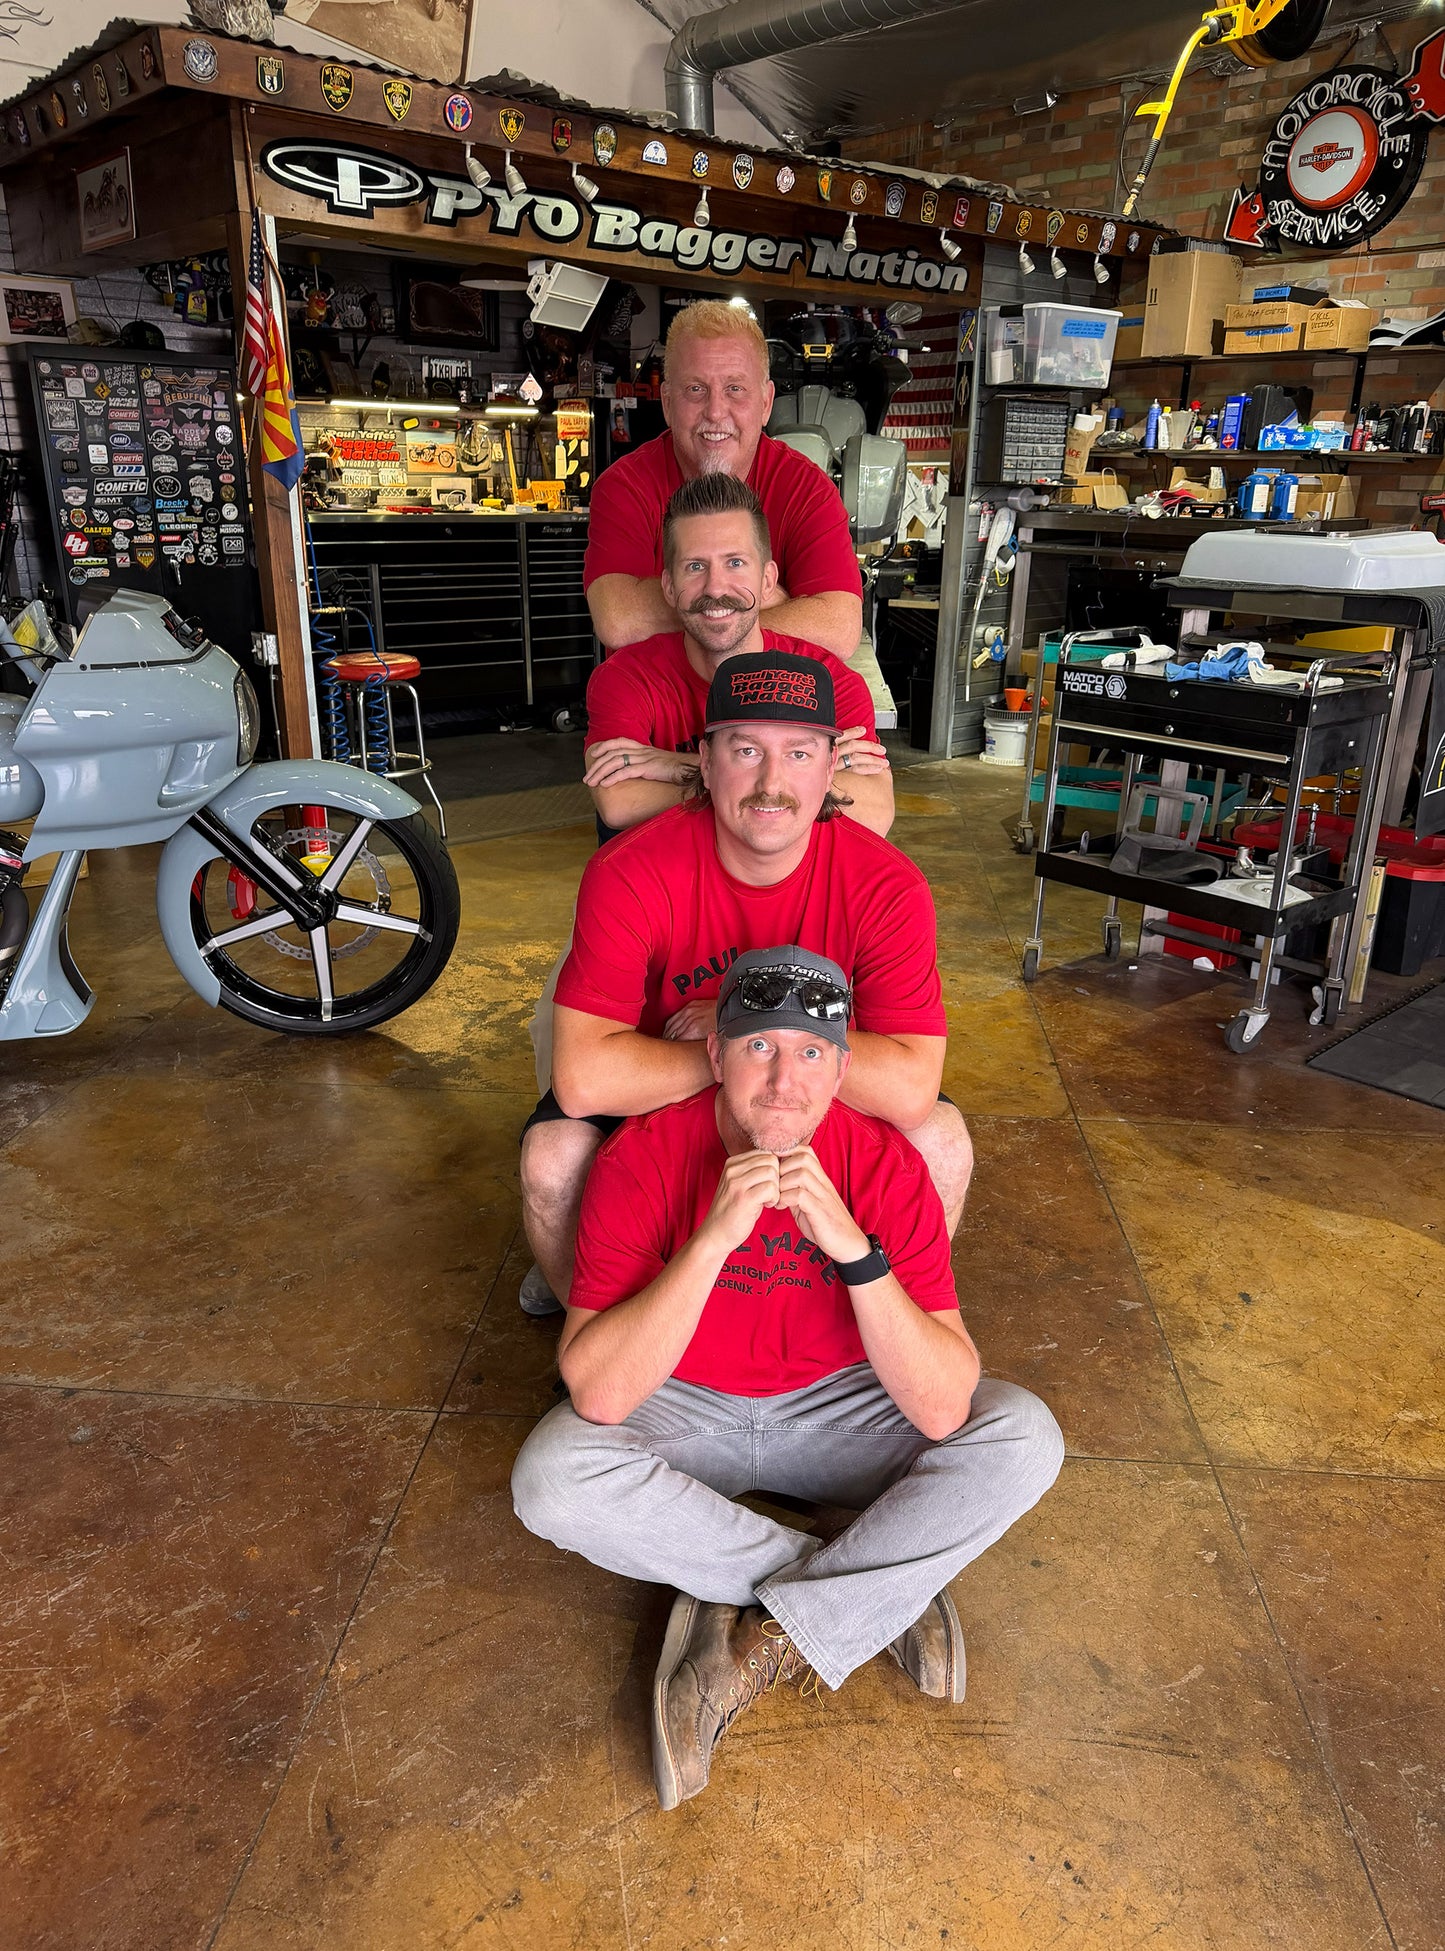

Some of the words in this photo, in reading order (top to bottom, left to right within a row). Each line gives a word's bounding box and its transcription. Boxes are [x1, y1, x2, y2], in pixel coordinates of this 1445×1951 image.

[260, 57, 282, 69] POLIZEI
[328, 95, 345, 104] POLICE
[1262, 73, 1411, 169] MOTORCYCLE
[1300, 150, 1351, 165] HARLEY-DAVIDSON
[736, 161, 752, 170] POLICE
[1267, 191, 1381, 244] SERVICE
[428, 175, 581, 238] PYO
[593, 202, 804, 270] Bagger
[811, 237, 969, 293] Nation
[165, 392, 212, 406] REBUFFINI
[560, 418, 572, 426] PAUL
[327, 430, 356, 438] Paul
[358, 430, 396, 440] Yaffe's
[330, 437, 396, 451] Bagger
[113, 454, 142, 463] COMETIC
[341, 448, 400, 461] Nation
[1066, 448, 1081, 458] ACE
[96, 480, 147, 493] COMETIC
[156, 499, 189, 509] Brock's
[731, 669, 767, 684] Paul
[767, 669, 817, 687] Yaffe's
[1063, 671, 1104, 685] MATCO
[731, 680, 817, 697] Bagger
[1063, 681, 1104, 695] TOOLS
[740, 690, 819, 711] Nation
[747, 964, 784, 975] Paul
[786, 965, 833, 984] Yaffe's
